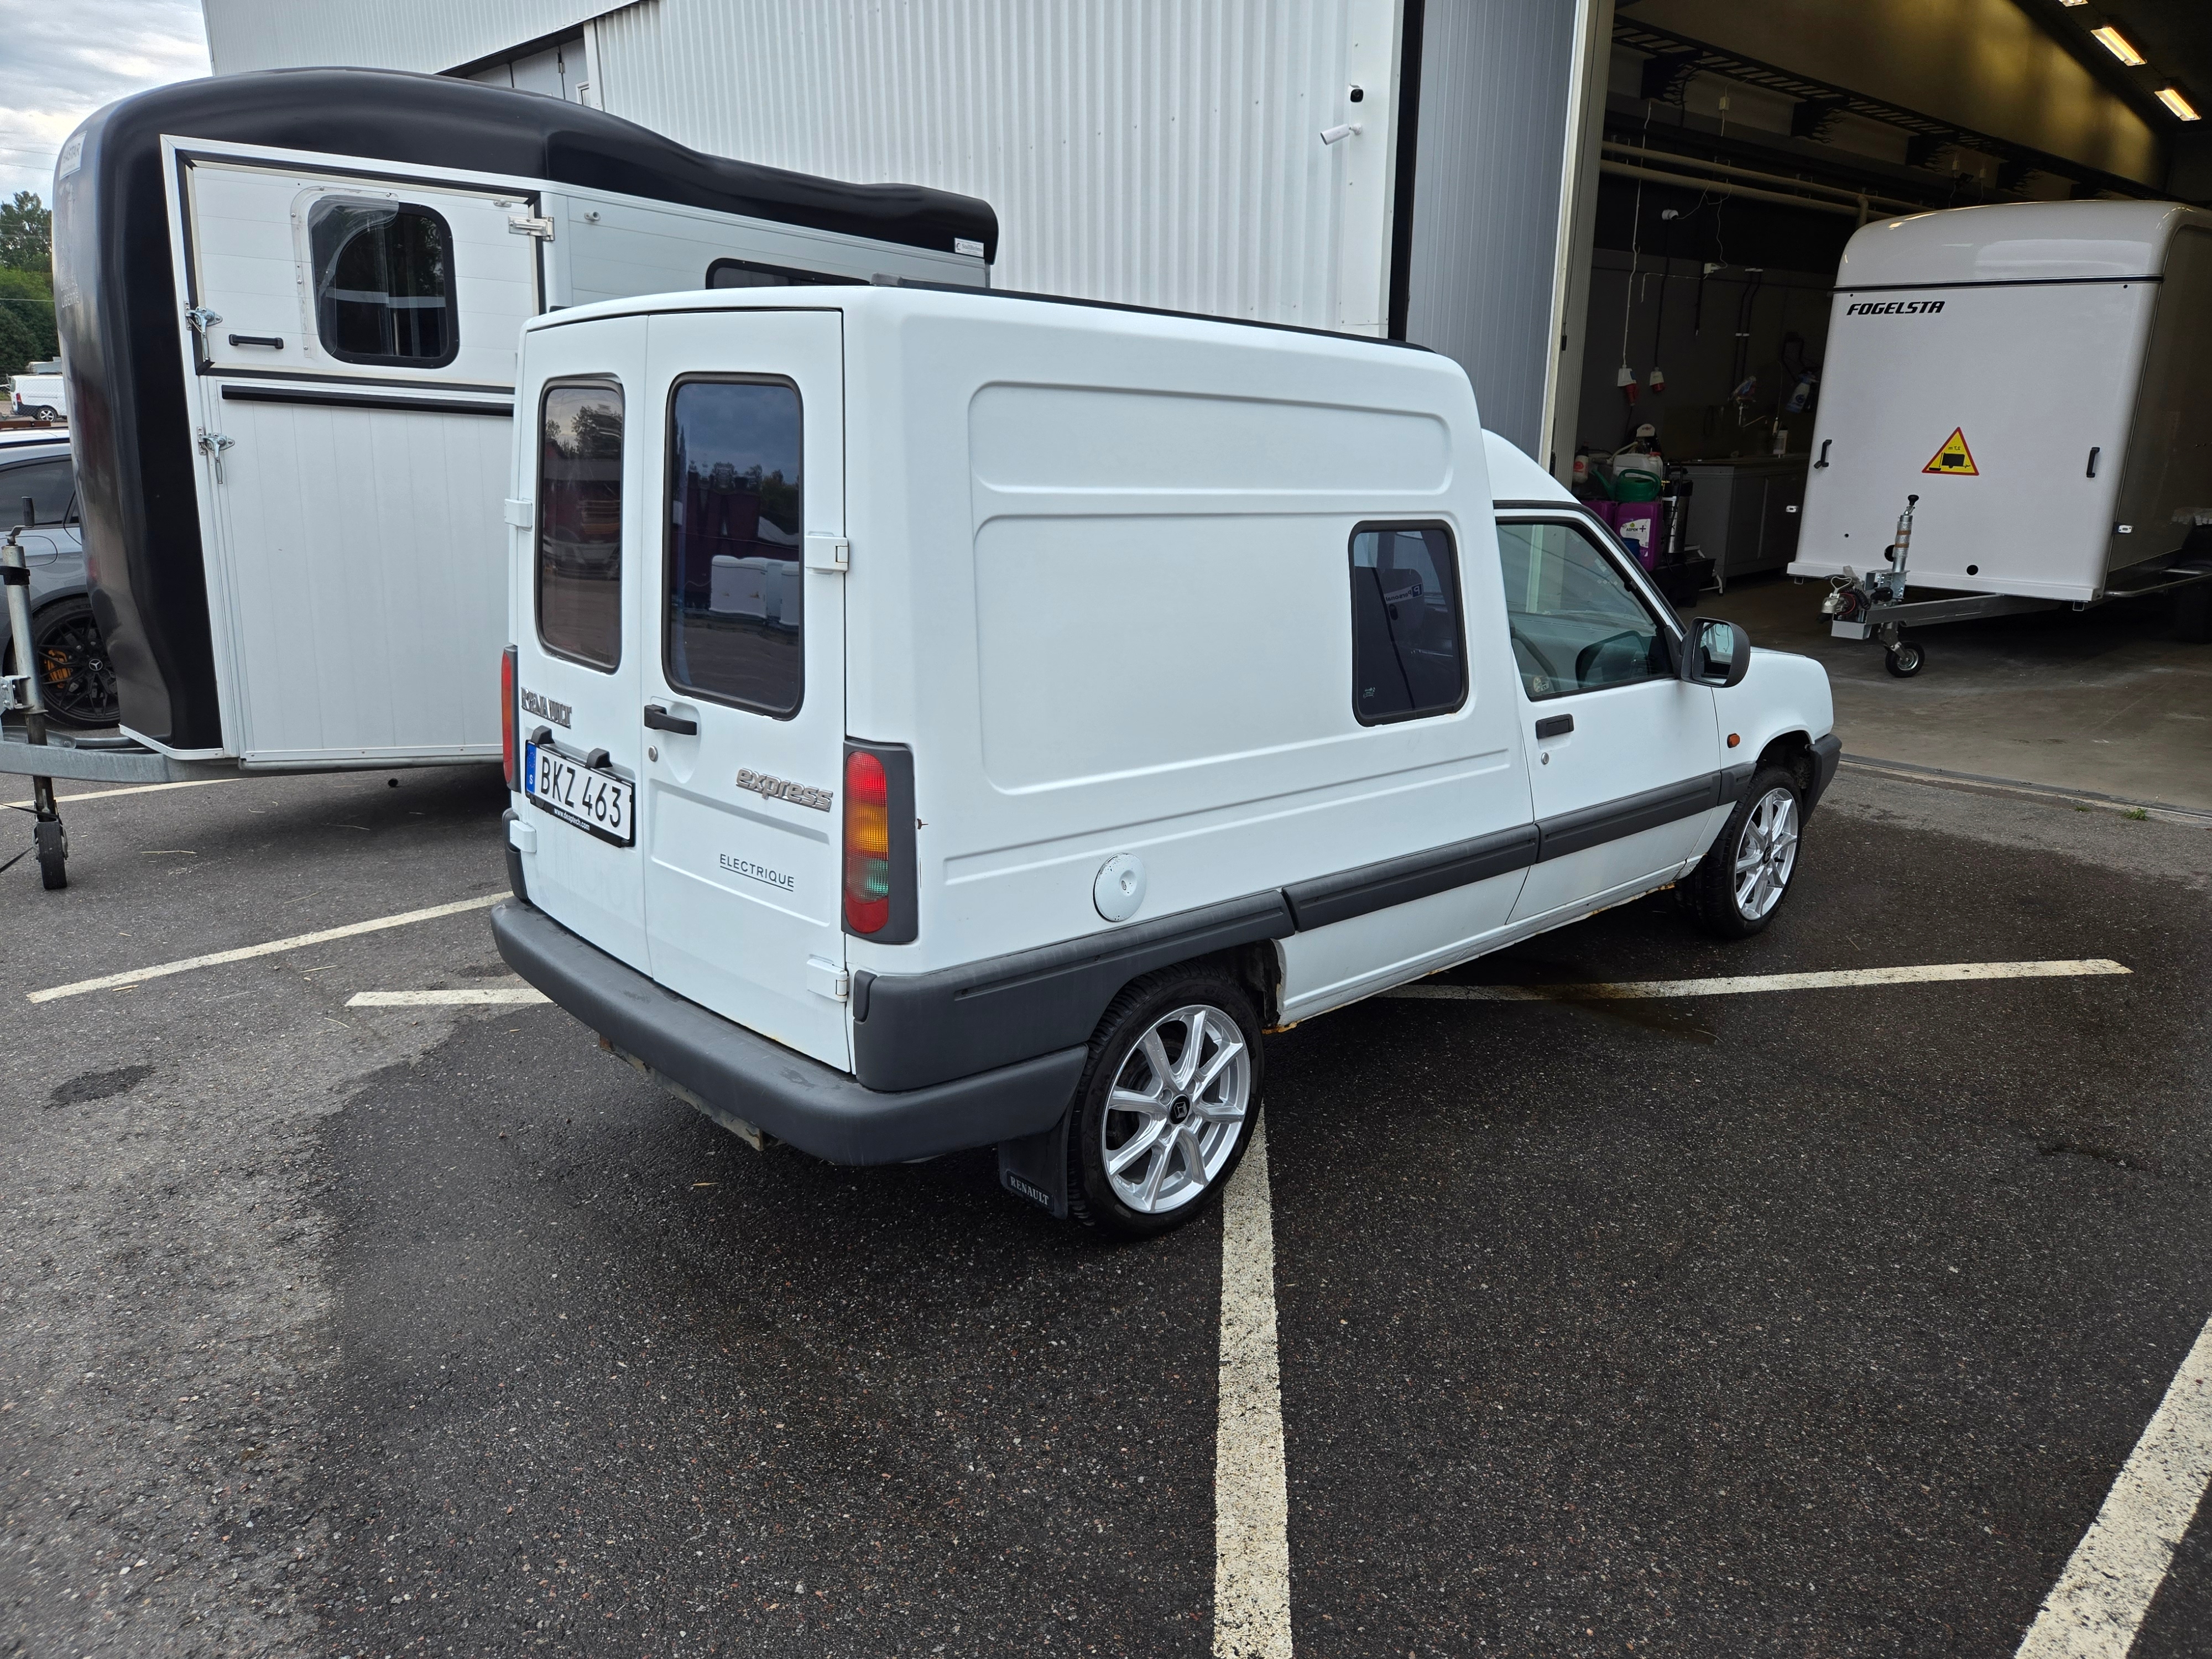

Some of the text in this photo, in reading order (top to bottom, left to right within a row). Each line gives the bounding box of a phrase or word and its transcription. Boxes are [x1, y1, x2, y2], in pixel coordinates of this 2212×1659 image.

[1846, 301, 1945, 316] FOGELSTA
[529, 774, 533, 785] S
[541, 755, 622, 828] BKZ 463
[736, 768, 833, 812] express
[554, 808, 590, 831] www.deaptech.com
[720, 853, 795, 888] ELECTRIQUE
[1010, 1176, 1049, 1205] RENAULT
